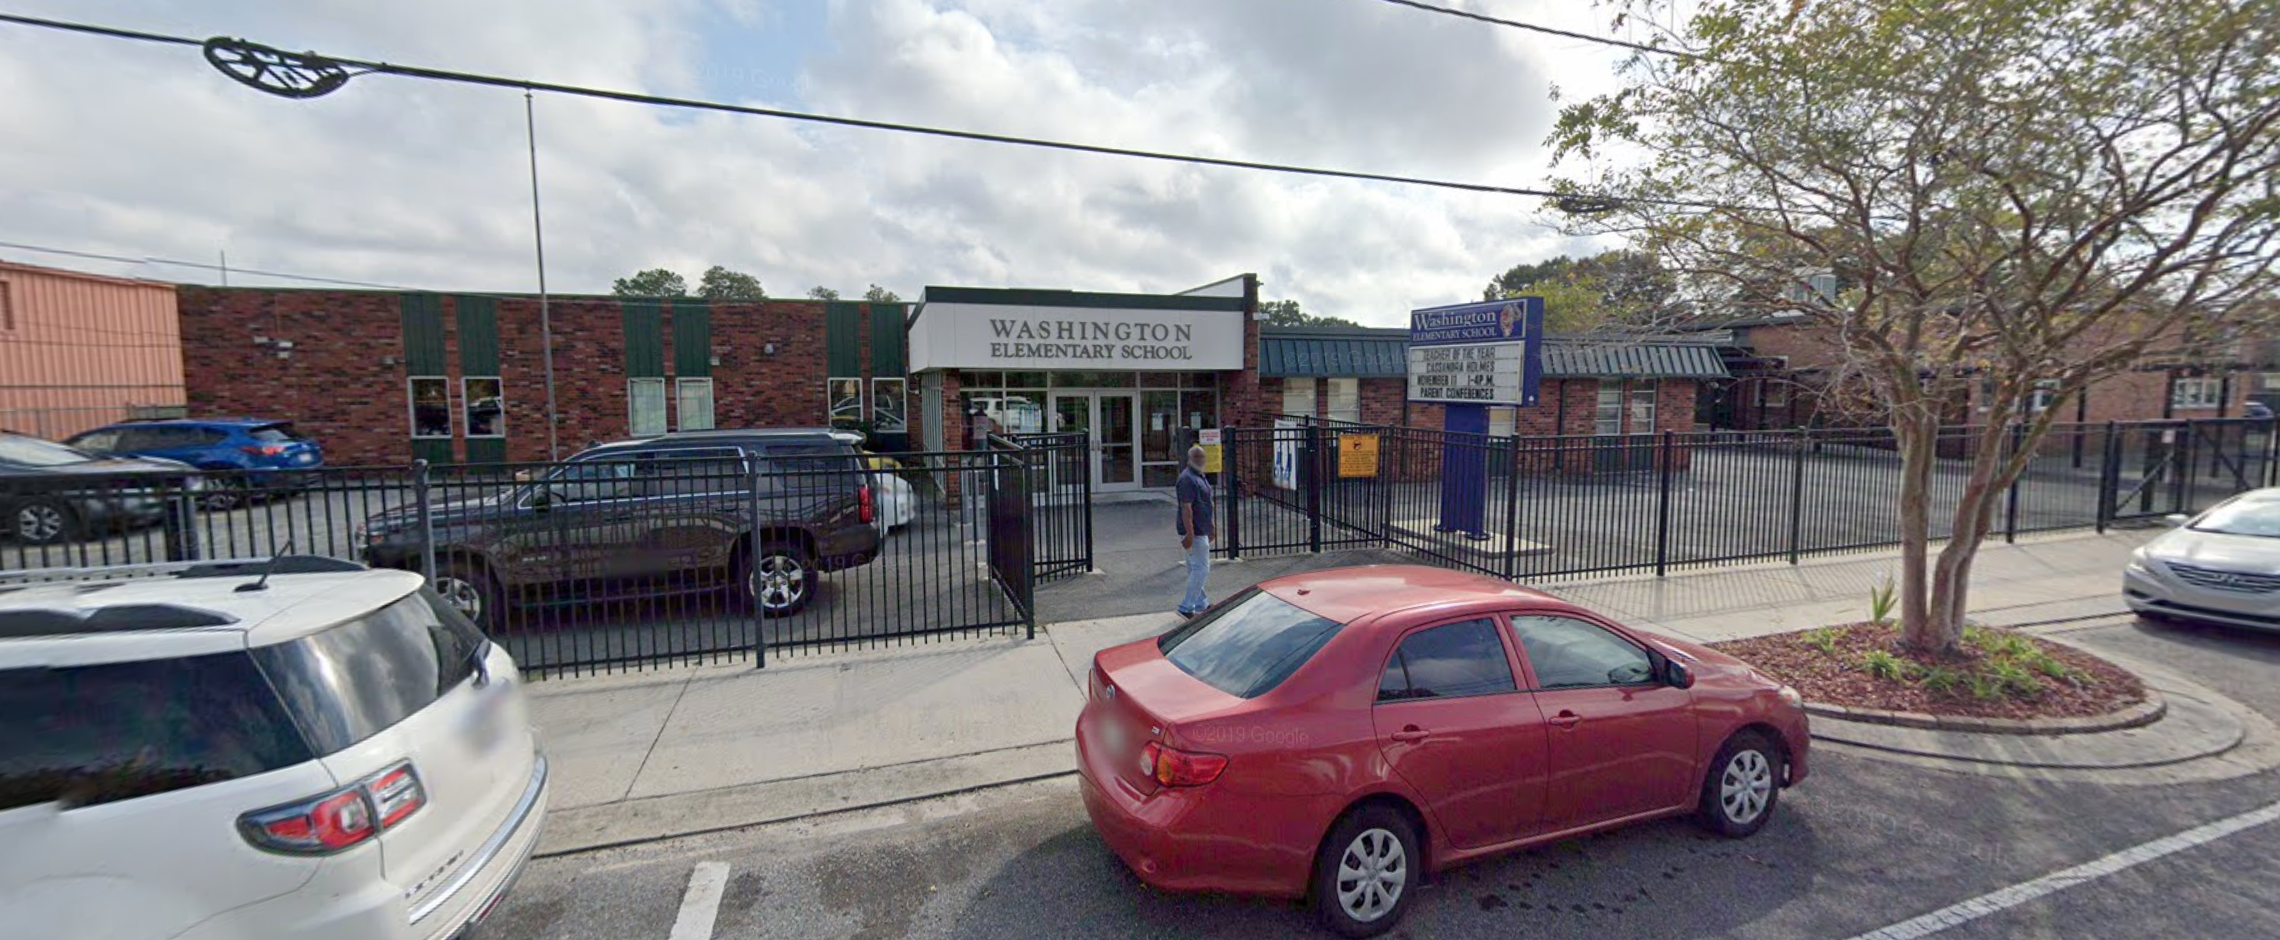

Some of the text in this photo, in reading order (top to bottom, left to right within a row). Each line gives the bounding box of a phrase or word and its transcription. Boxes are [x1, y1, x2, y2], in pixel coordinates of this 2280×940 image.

[1414, 312, 1496, 331] Washington
[990, 319, 1192, 341] WASHINGTON
[1413, 327, 1497, 341] ELEMENTARY SCHOOL
[990, 343, 1193, 360] ELEMENTARY SCHOOL
[1423, 346, 1496, 360] TEACHER OF THE YEAR
[1417, 374, 1449, 386] NOVEMBER
[1420, 387, 1495, 400] PARENT CONFERENCES
